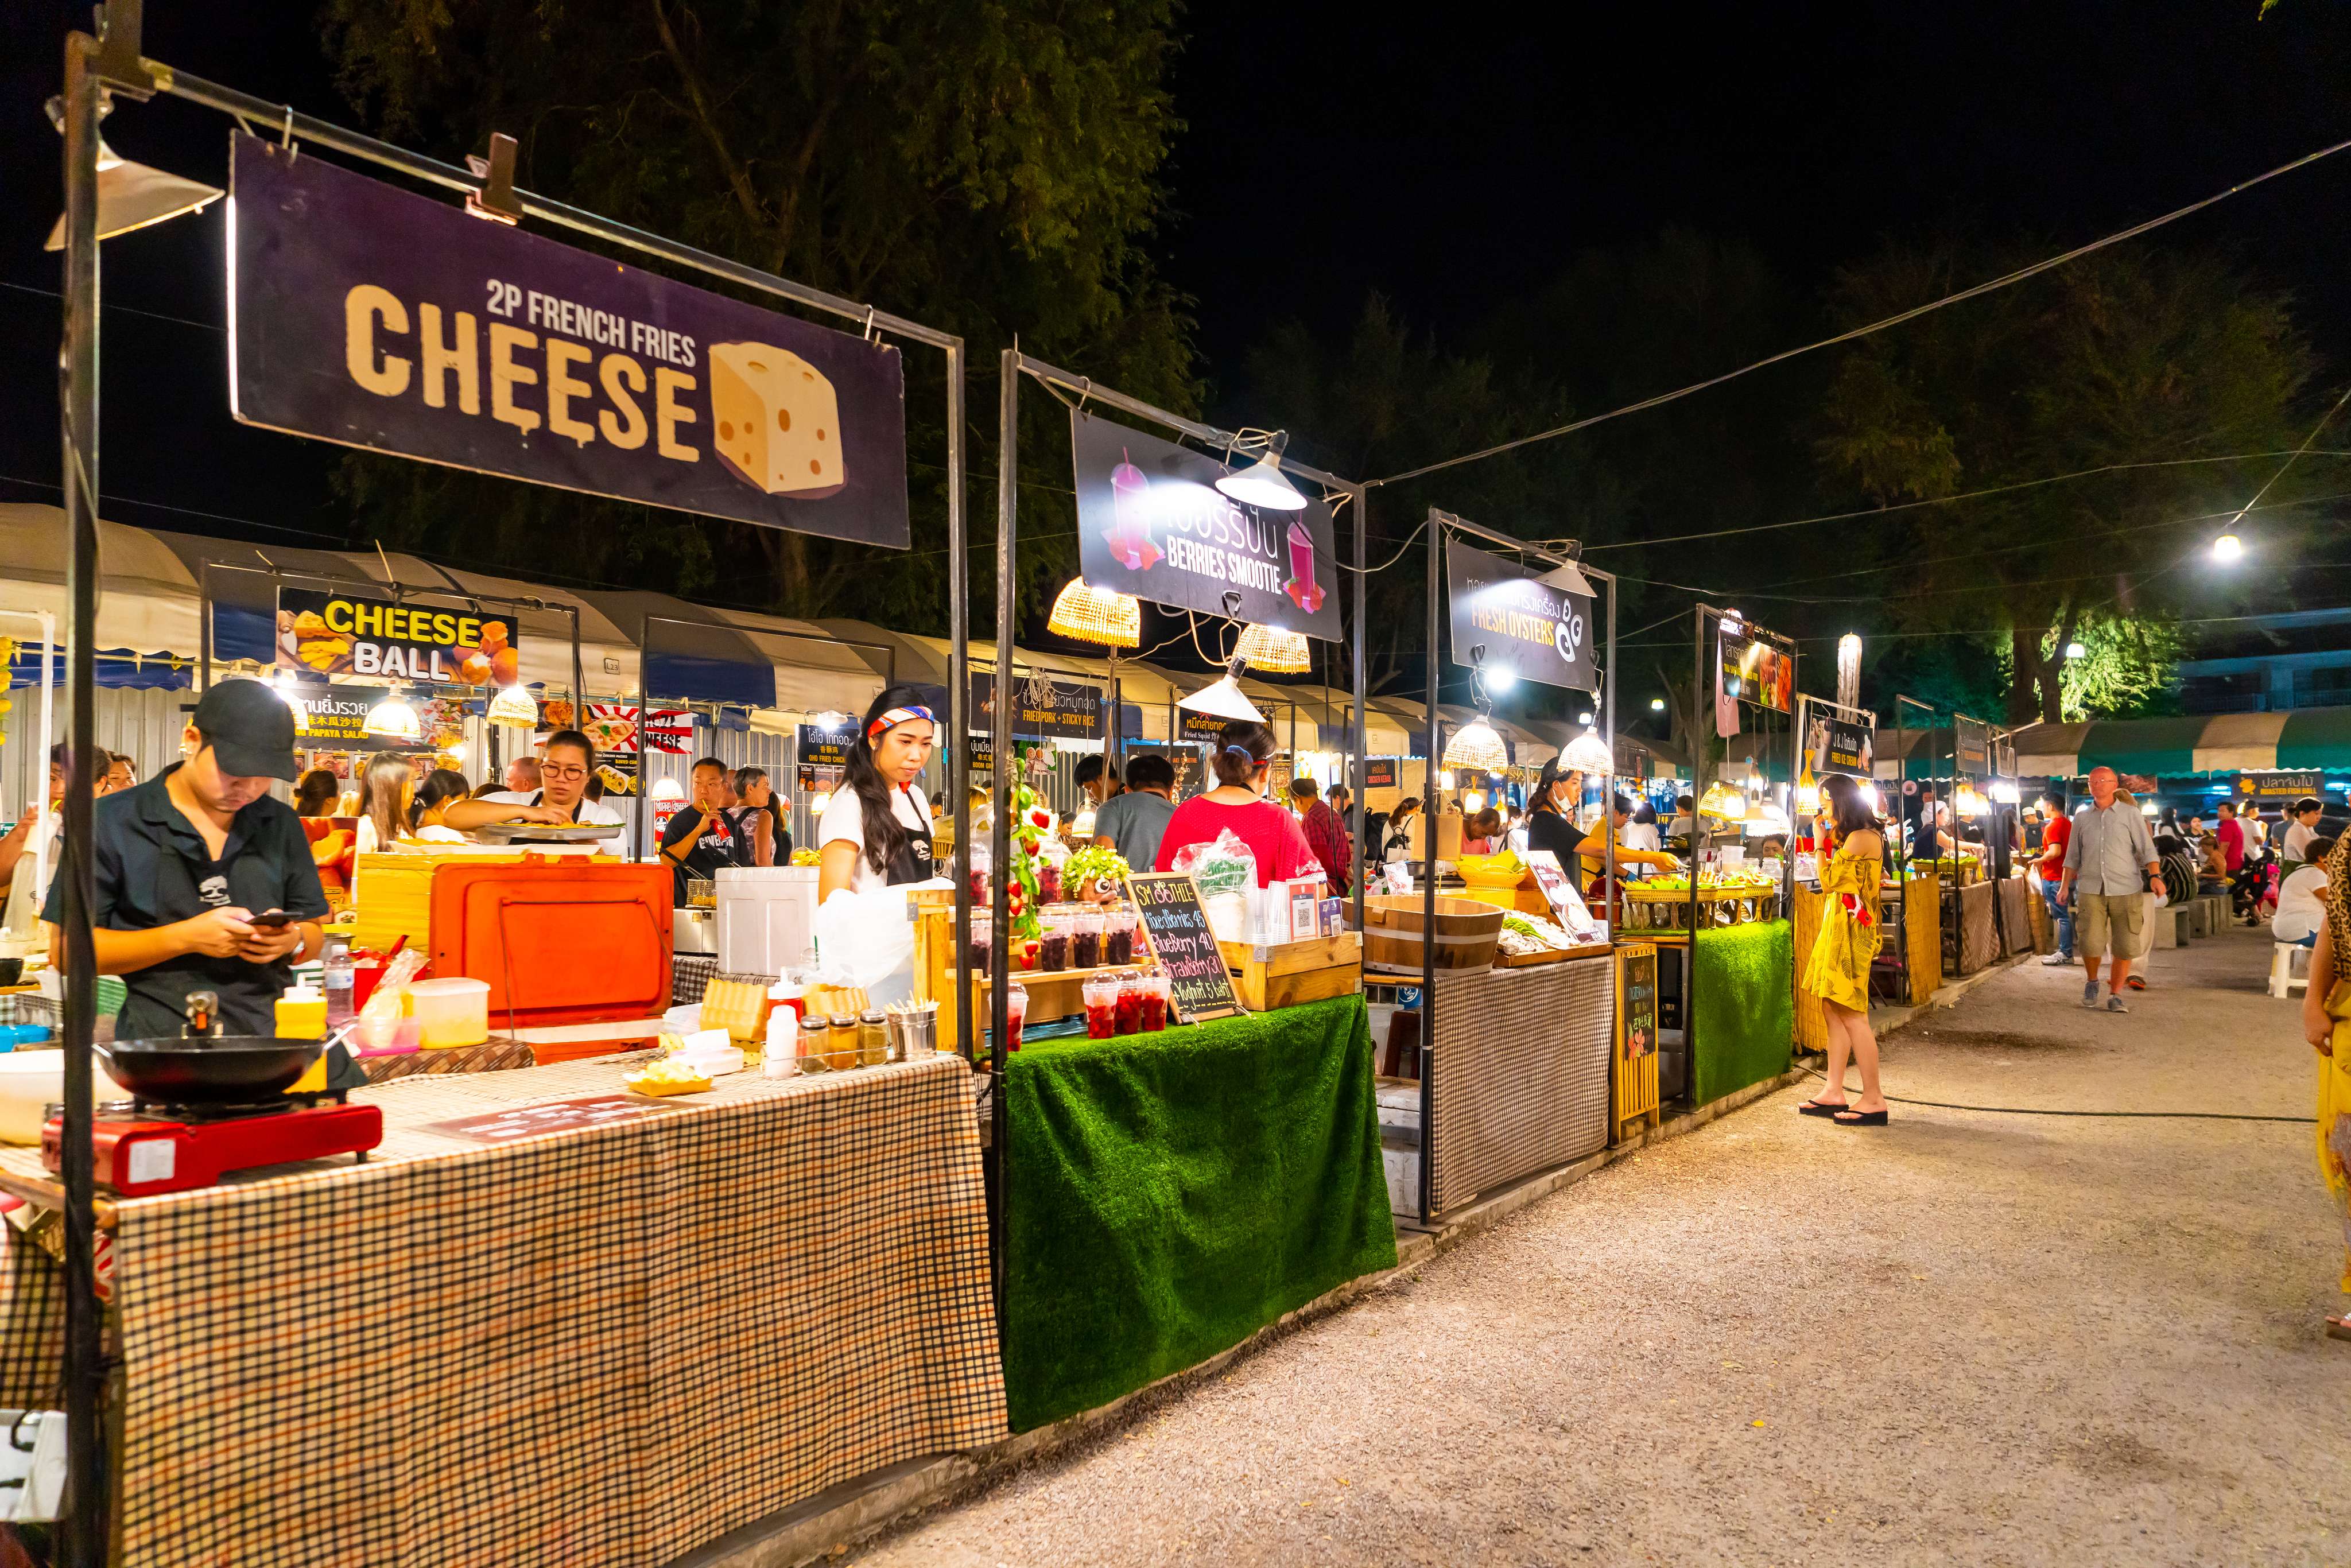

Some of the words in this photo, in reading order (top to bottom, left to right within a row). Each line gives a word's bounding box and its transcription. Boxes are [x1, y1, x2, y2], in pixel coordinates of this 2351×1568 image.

[486, 278, 523, 317] 2P
[527, 290, 626, 351] FRENCH
[631, 319, 697, 369] FRIES
[344, 284, 700, 464] CHEESE
[1166, 534, 1225, 581] BERRIES
[1227, 550, 1282, 596] SMOOTIE
[324, 600, 480, 649] CHEESE
[1472, 598, 1507, 635] FRESH
[1508, 611, 1555, 647] OYSTERS
[354, 642, 452, 682] BALL
[607, 662, 618, 671] L23
[1023, 709, 1039, 722] FRIED
[1041, 711, 1057, 724] PORK
[1062, 713, 1082, 726] STICKY
[1083, 715, 1095, 727] RICE
[309, 729, 340, 738] PAPAYA
[343, 729, 369, 739] SALAD
[645, 733, 681, 750] HEESE
[1197, 732, 1211, 740] Squid
[1832, 751, 1841, 764] FRIED
[1846, 755, 1857, 767] CREAM
[1381, 775, 1391, 783] KEBAB
[1136, 881, 1195, 906] SMOOTHIE
[1193, 910, 1206, 928] 45
[1198, 932, 1215, 952] 40
[1211, 954, 1223, 975] 30
[1206, 982, 1213, 999] 5
[1214, 977, 1231, 999] baht
